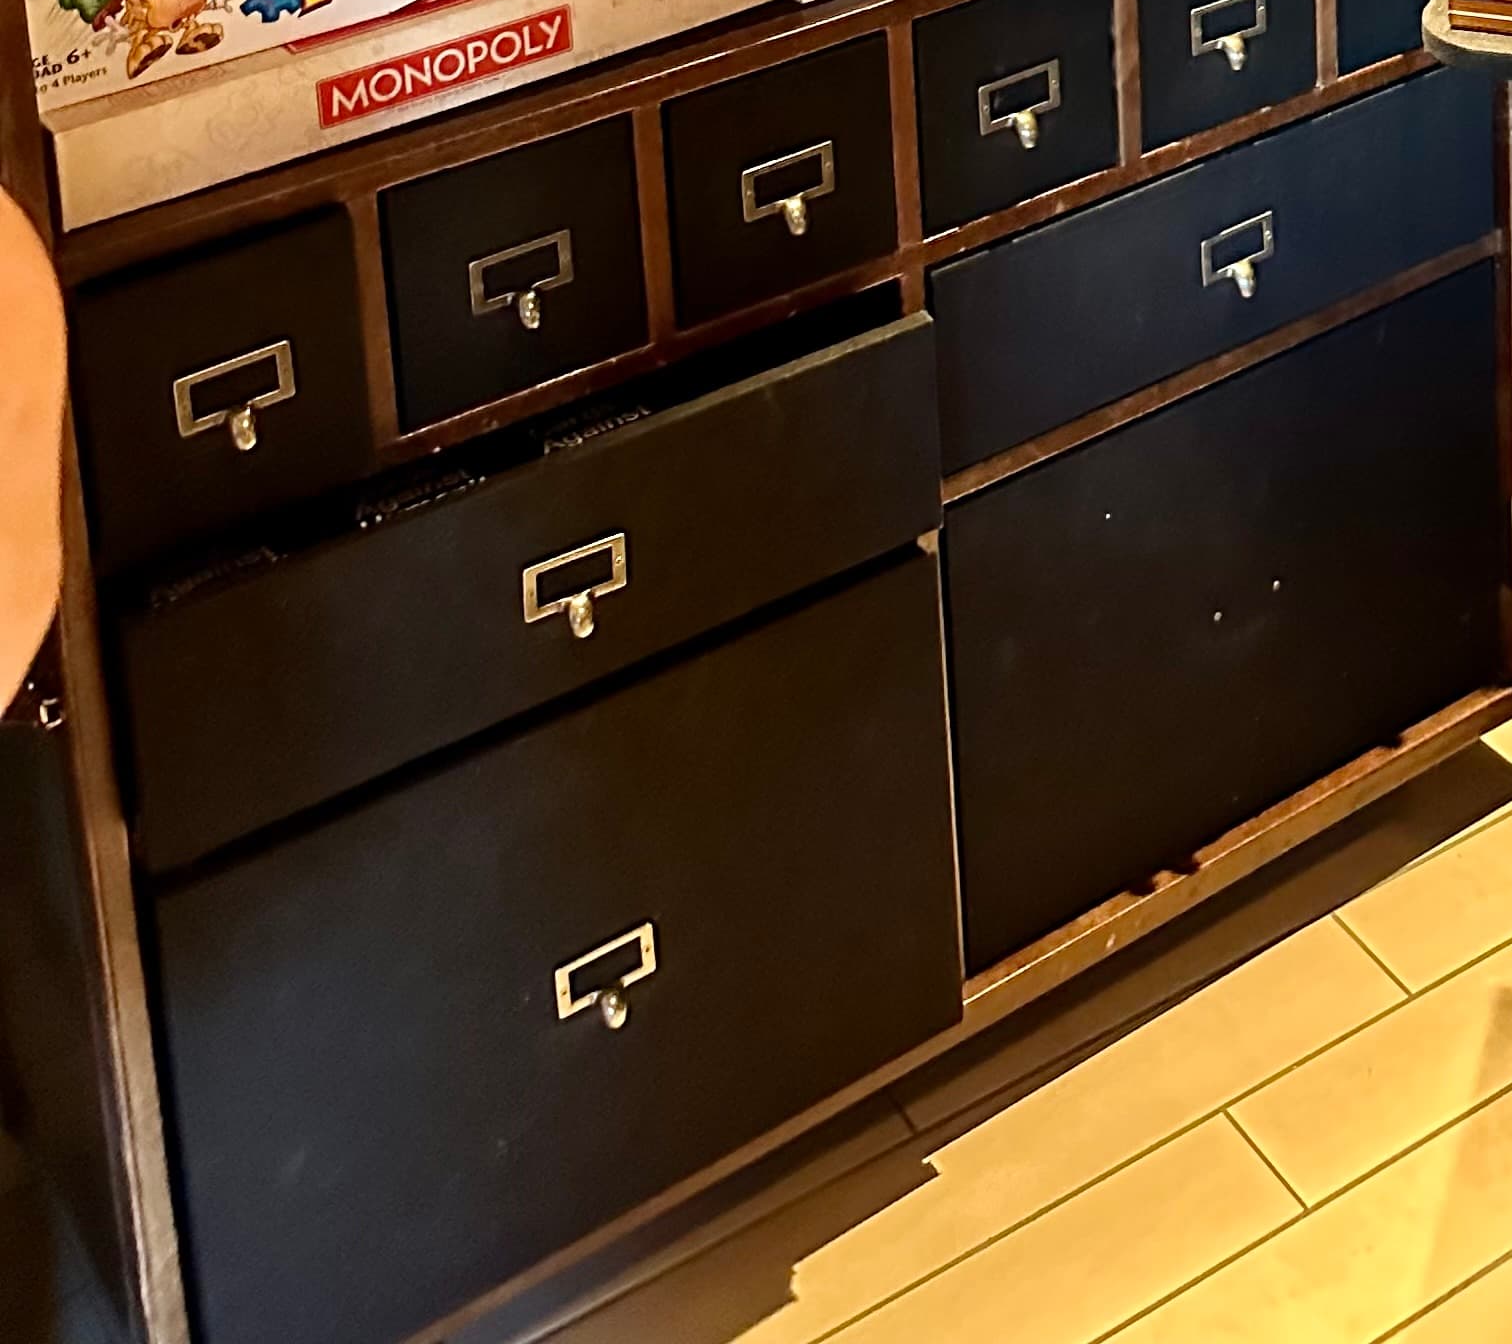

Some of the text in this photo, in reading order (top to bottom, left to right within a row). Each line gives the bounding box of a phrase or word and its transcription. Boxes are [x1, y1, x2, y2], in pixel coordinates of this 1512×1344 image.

[31, 48, 92, 68] GE 6+
[330, 14, 564, 119] MONOPOLY
